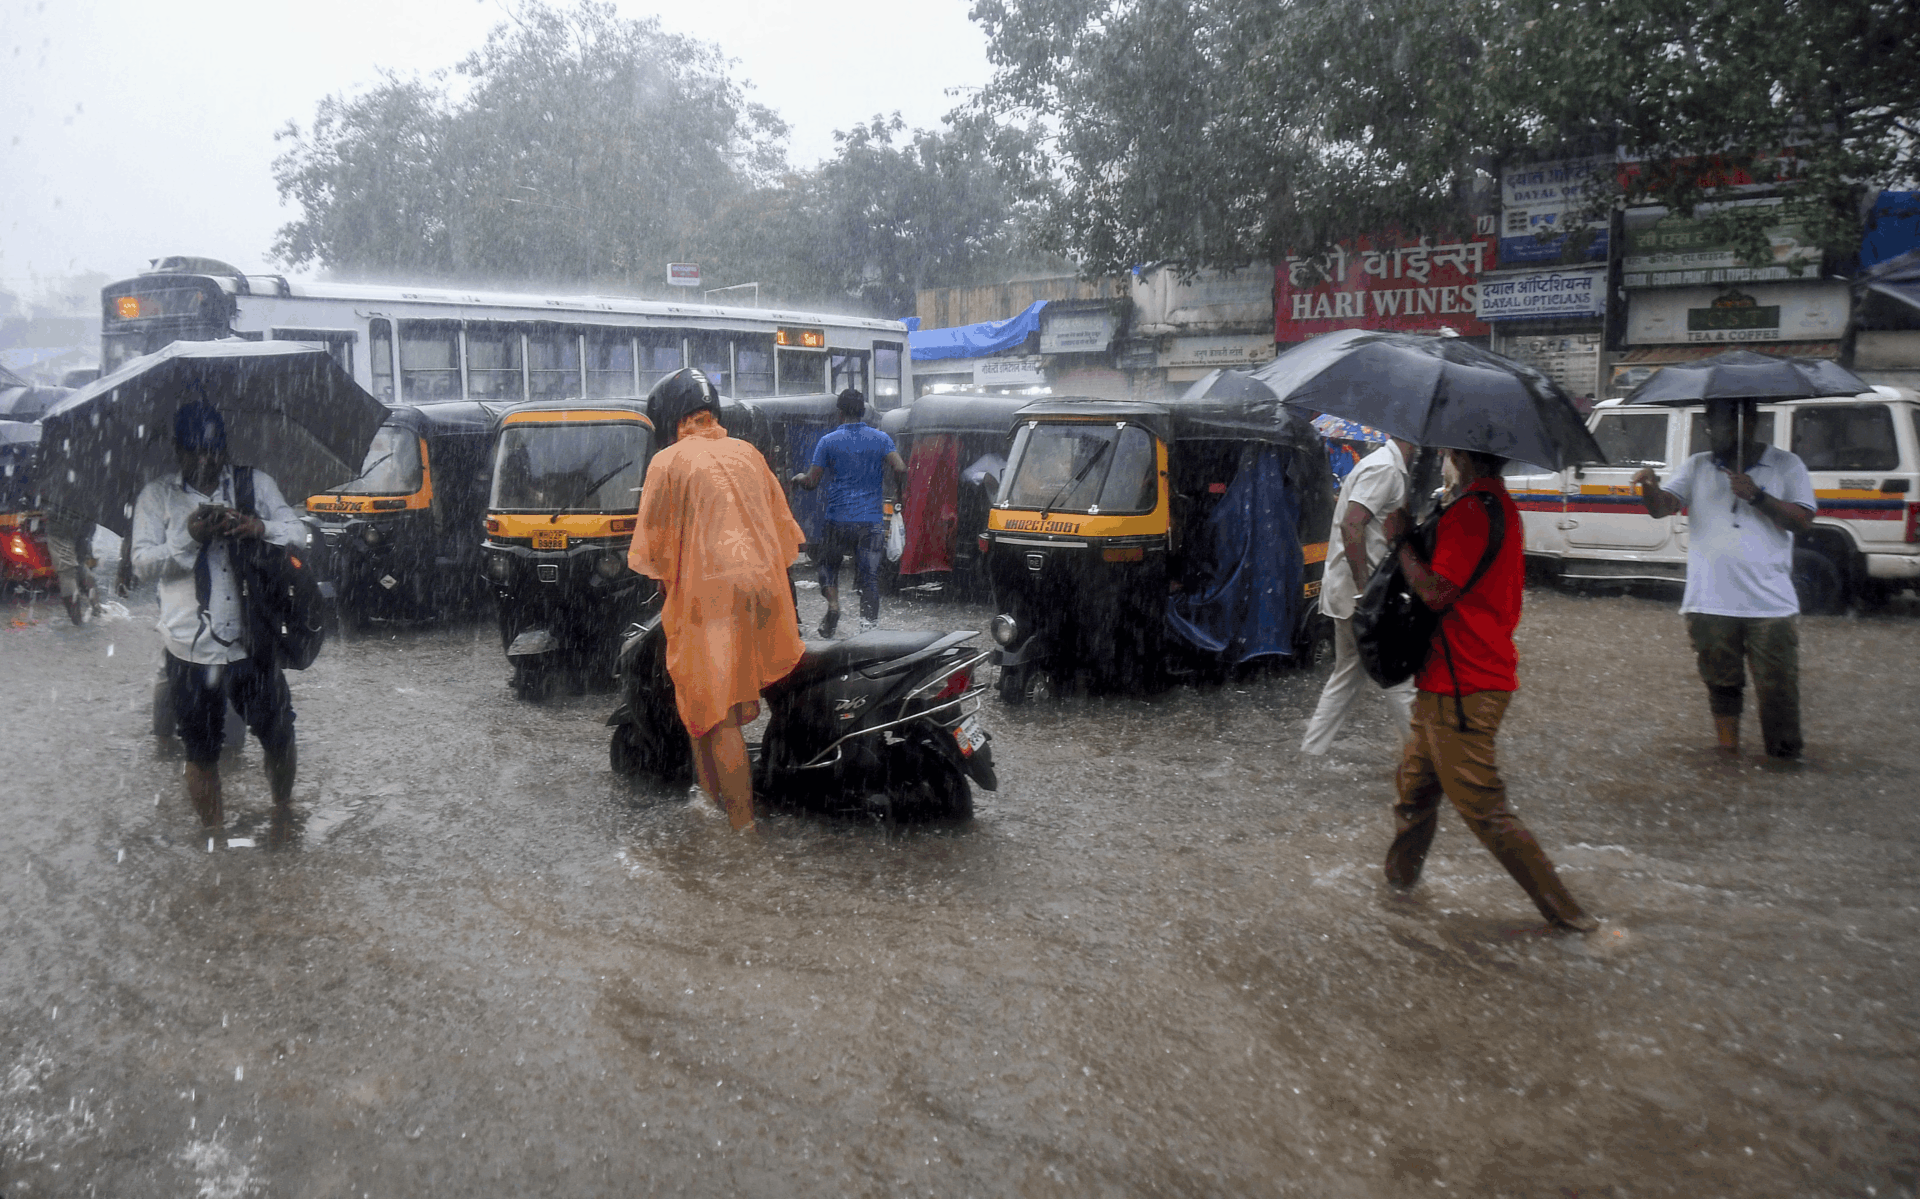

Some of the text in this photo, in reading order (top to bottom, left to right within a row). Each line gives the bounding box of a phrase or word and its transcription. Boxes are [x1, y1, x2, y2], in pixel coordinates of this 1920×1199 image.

[1514, 189, 1556, 201] DAYAL
[1482, 274, 1593, 298] दयाल ऑप्टिशियन्स
[1291, 284, 1477, 320] HARI WINES
[1482, 293, 1591, 309] DAYAL OPTICIANS
[1687, 330, 1779, 341] TEA & COFFEE
